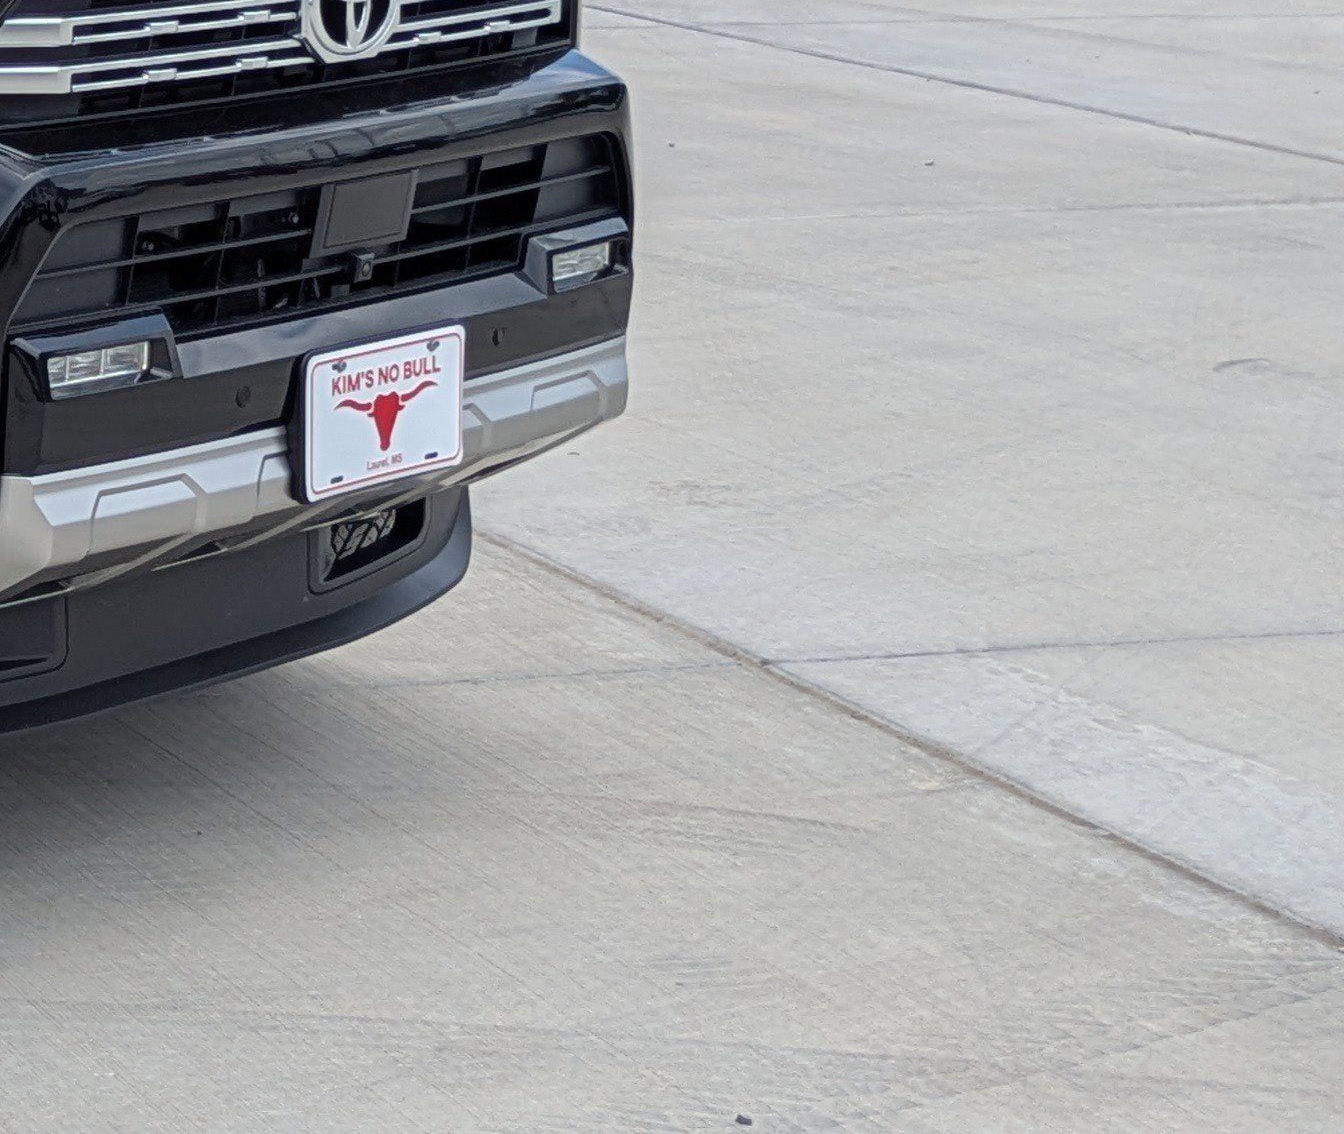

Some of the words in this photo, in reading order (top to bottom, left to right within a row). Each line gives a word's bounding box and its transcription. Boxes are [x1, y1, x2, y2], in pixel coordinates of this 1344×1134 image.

[332, 371, 374, 397] KIM'S
[378, 364, 400, 385] NO
[403, 355, 442, 380] BULL
